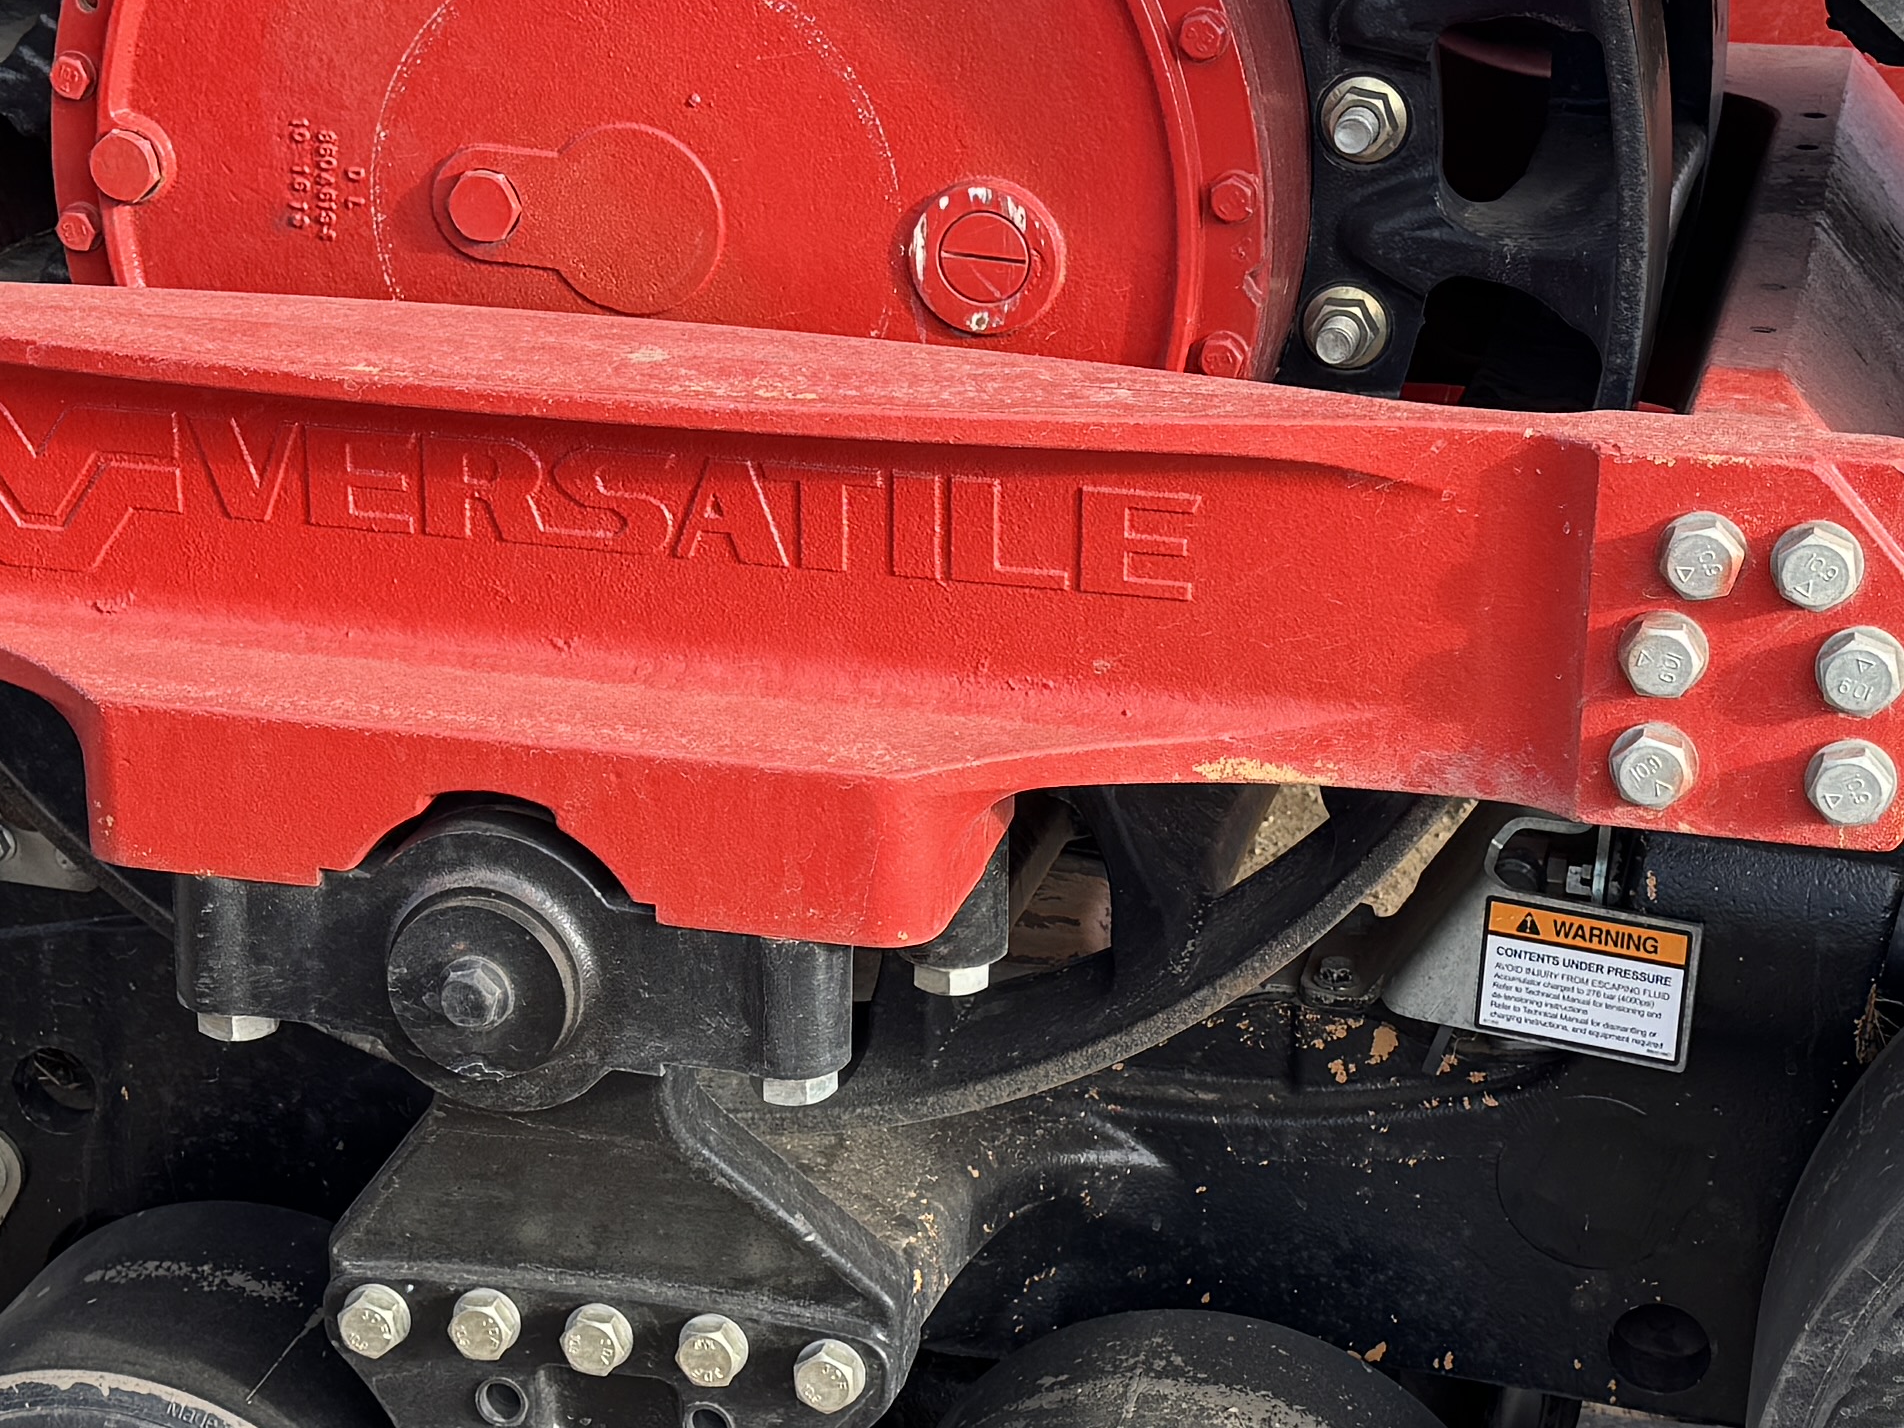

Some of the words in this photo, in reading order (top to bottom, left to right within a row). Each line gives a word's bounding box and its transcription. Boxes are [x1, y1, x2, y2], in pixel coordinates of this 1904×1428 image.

[190, 409, 1205, 604] VERSATILE
[1551, 918, 1659, 956] WARNING
[1494, 961, 1522, 973] AVOID
[1525, 966, 1559, 980] INJURY
[1561, 973, 1589, 985] FROM
[1591, 978, 1640, 995] ESCAPING
[1642, 987, 1670, 1001] FLUID
[1496, 945, 1560, 966] CONTENTS
[1562, 957, 1604, 974] UNDER
[1606, 965, 1672, 986] PRESSURE
[1492, 981, 1512, 991] Refer
[1514, 985, 1522, 993] to
[1524, 987, 1560, 1000] Technical
[1562, 993, 1590, 1005] Manual
[1592, 999, 1602, 1007] for
[1604, 1001, 1644, 1017] tensioning
[1646, 1010, 1662, 1019] and
[1493, 971, 1540, 986] Accumulator
[1542, 980, 1574, 994] charged
[1576, 986, 1584, 994] to
[1603, 991, 1616, 1000] bar
[1489, 1010, 1522, 1024] charging
[1571, 1025, 1586, 1035] and
[1588, 1028, 1629, 1043] equipment
[1490, 999, 1510, 1010] Refer
[1512, 1003, 1520, 1012] to
[1522, 1005, 1557, 1019] Technical
[1559, 1012, 1588, 1025] Manual
[1590, 1018, 1600, 1027] for
[1544, 1000, 1588, 1015] instructions
